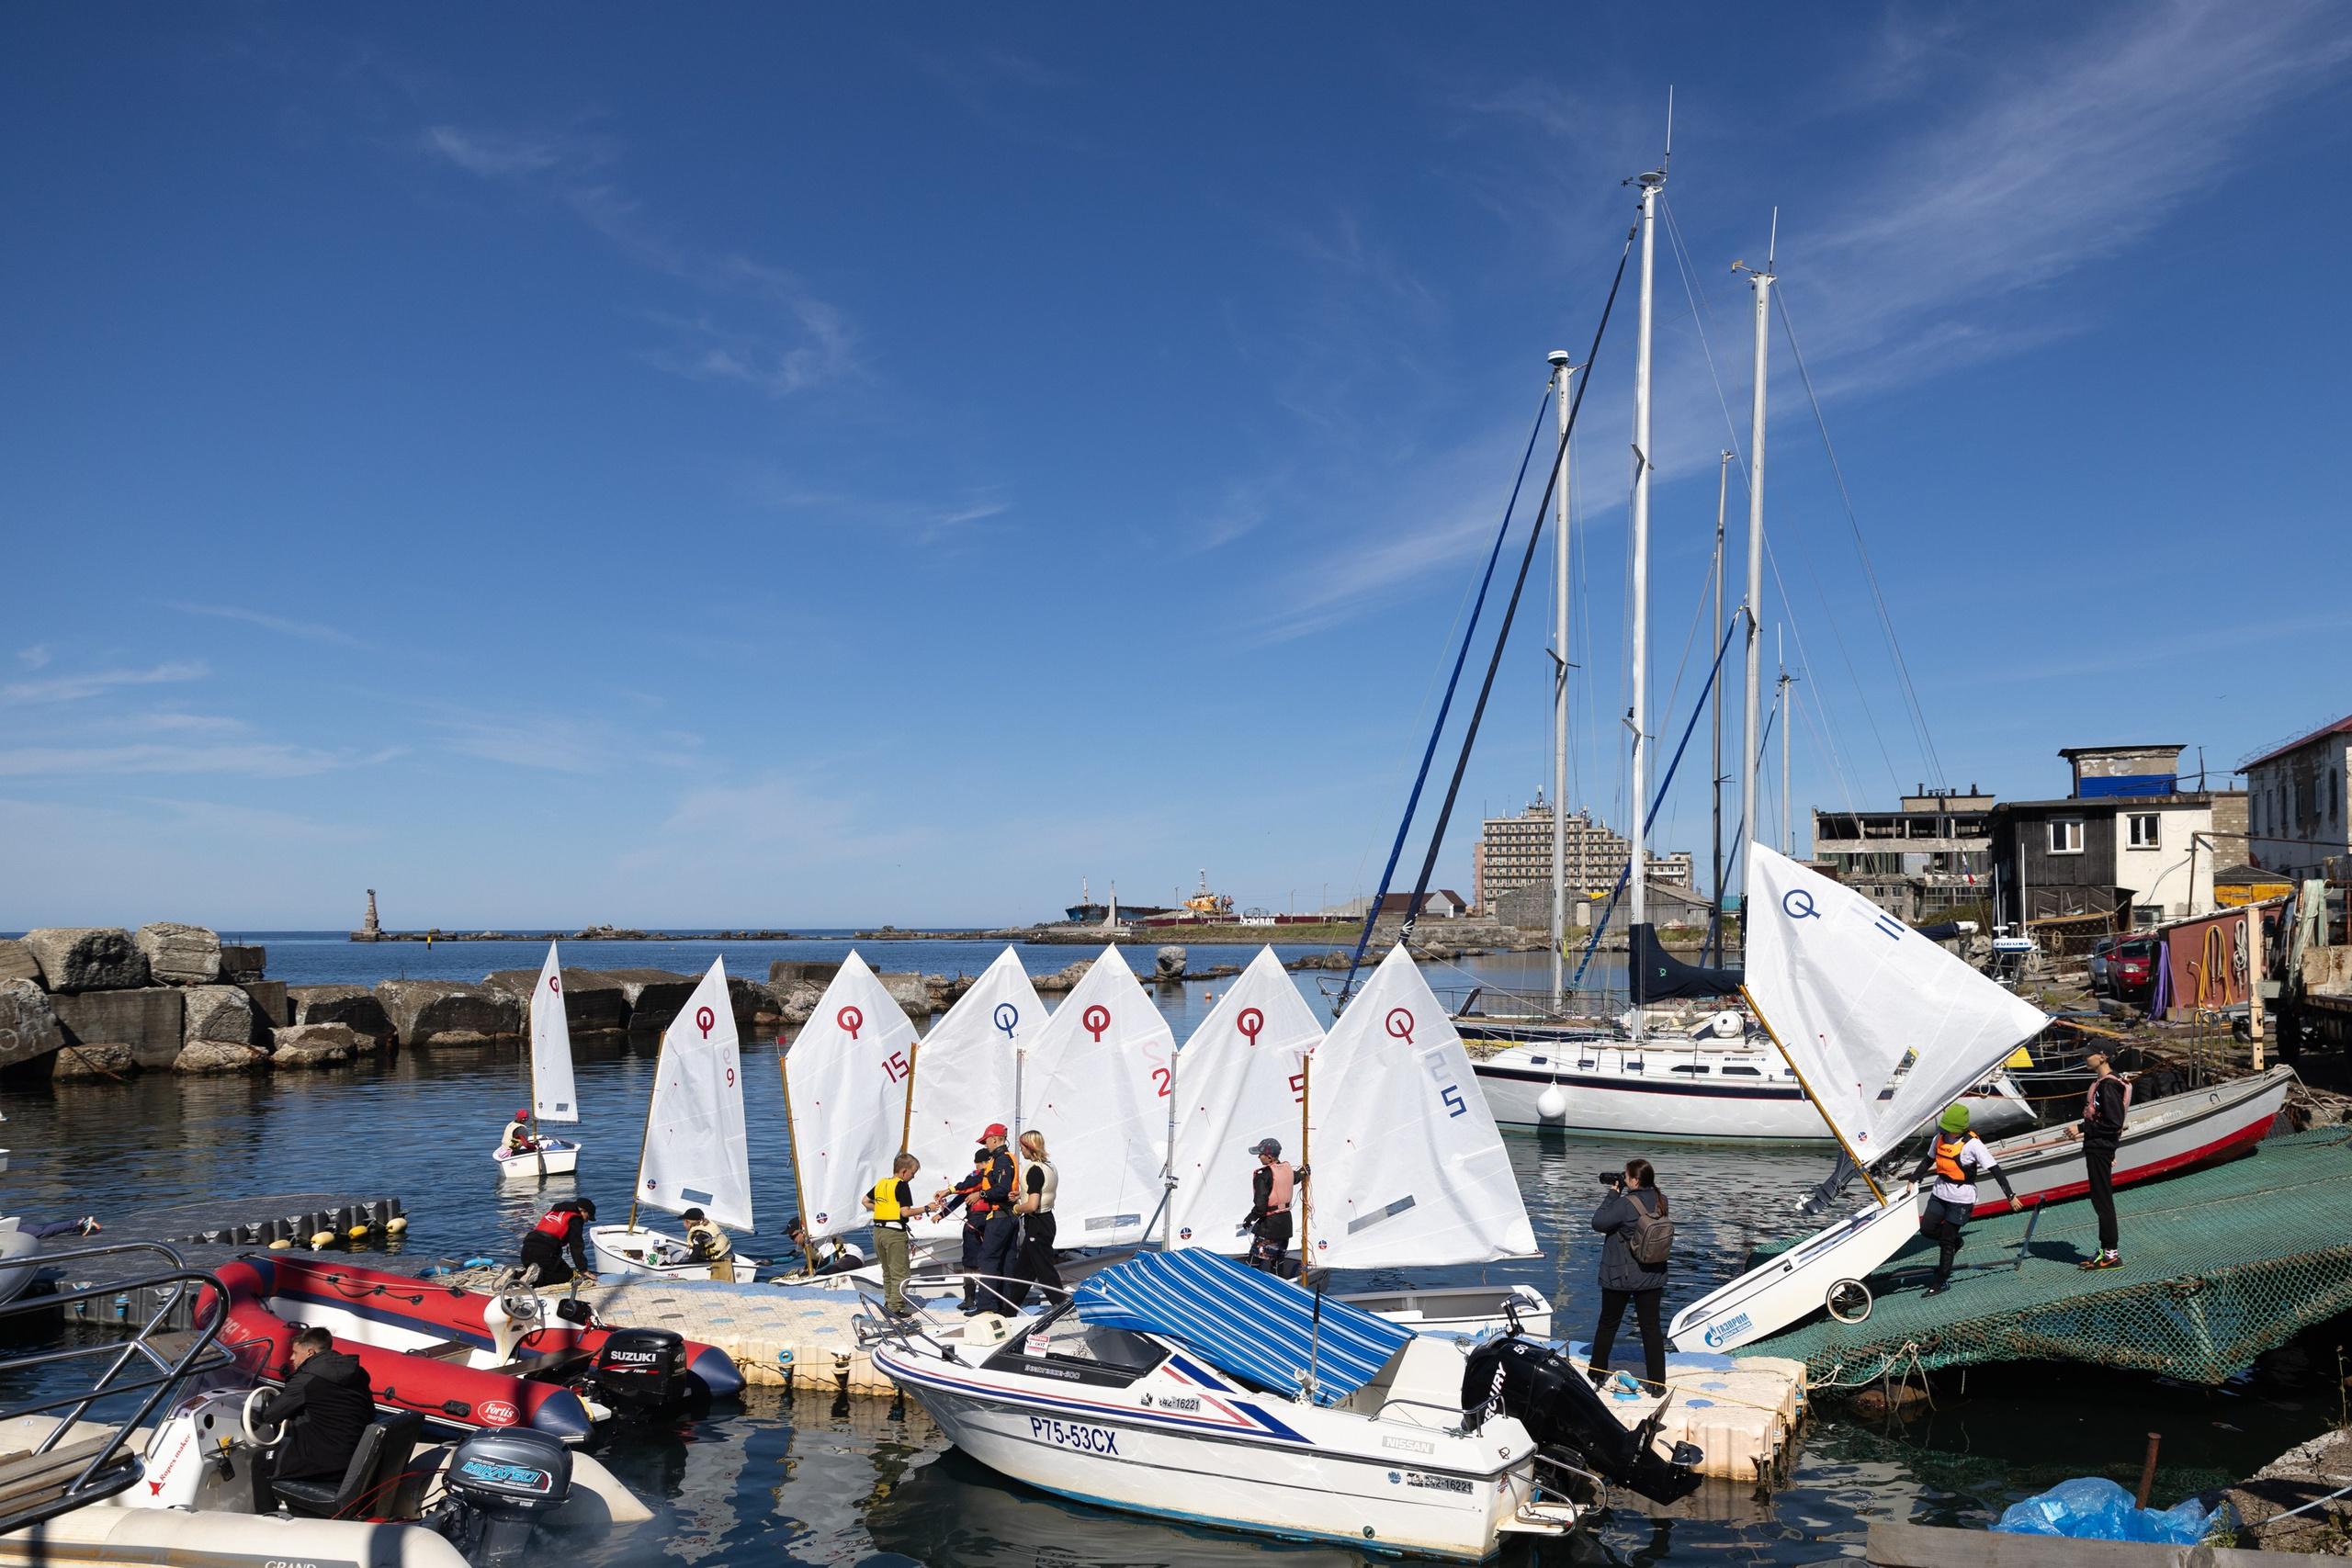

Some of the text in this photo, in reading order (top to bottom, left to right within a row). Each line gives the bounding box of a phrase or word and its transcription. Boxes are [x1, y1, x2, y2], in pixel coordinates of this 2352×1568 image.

[882, 1051, 910, 1083] 15
[727, 1068, 734, 1088] 9
[1152, 1068, 1170, 1097] 2
[1441, 1085, 1467, 1118] 5
[1716, 1313, 1748, 1334] ГАЗПРОМ
[610, 1350, 657, 1362] SUZUKI
[1513, 1344, 1529, 1355] 50
[484, 1403, 514, 1418] Fortis
[1386, 1437, 1430, 1452] NISSAN
[159, 1434, 191, 1482] Ropes maker
